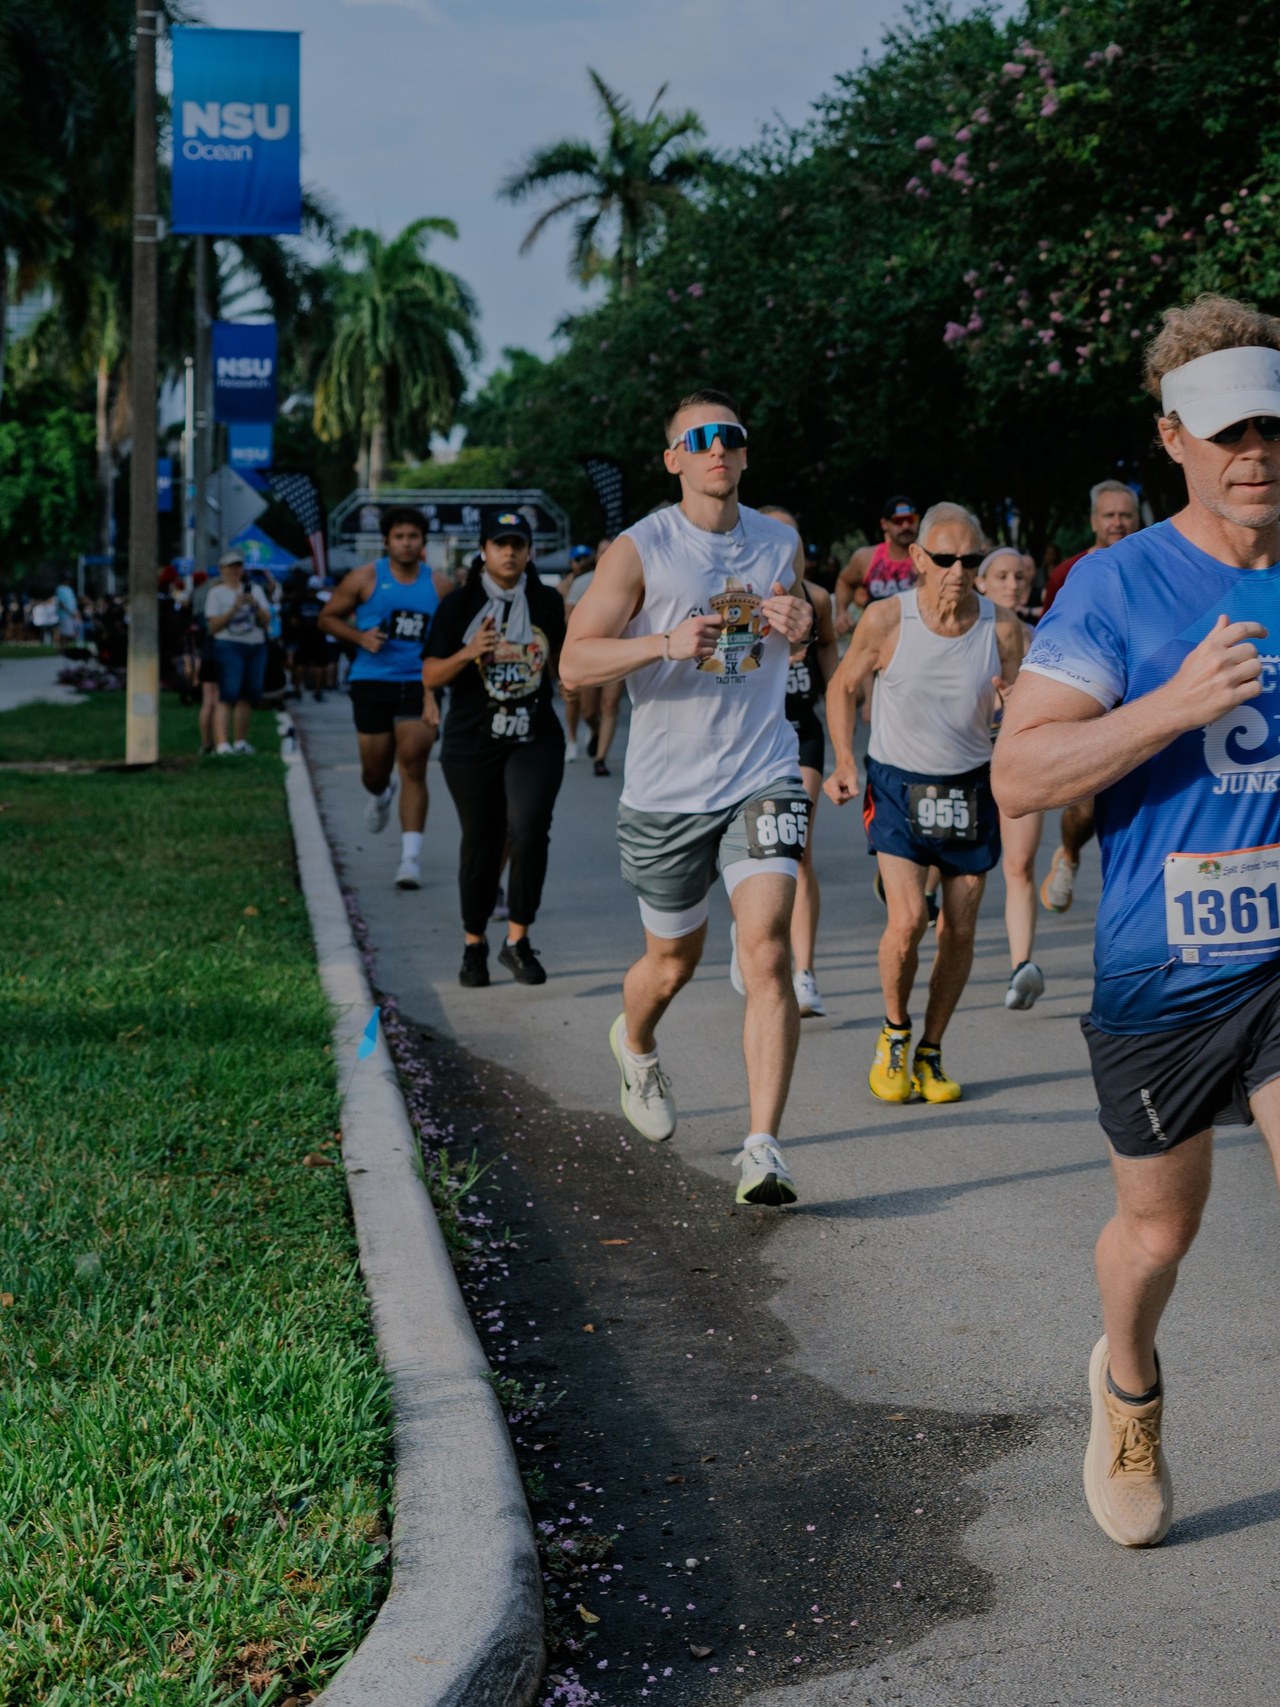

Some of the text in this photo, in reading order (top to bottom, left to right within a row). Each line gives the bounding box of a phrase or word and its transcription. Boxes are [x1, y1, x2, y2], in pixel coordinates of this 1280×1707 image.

[182, 100, 291, 140] NSU
[183, 140, 253, 161] Ocean
[216, 357, 272, 378] NSU
[870, 578, 917, 598] BAS
[725, 661, 738, 675] 5K
[787, 667, 811, 694] 55
[491, 713, 530, 737] 876
[949, 788, 965, 800] 5K
[790, 801, 807, 814] 5K
[917, 798, 969, 830] 955
[756, 812, 809, 847] 865
